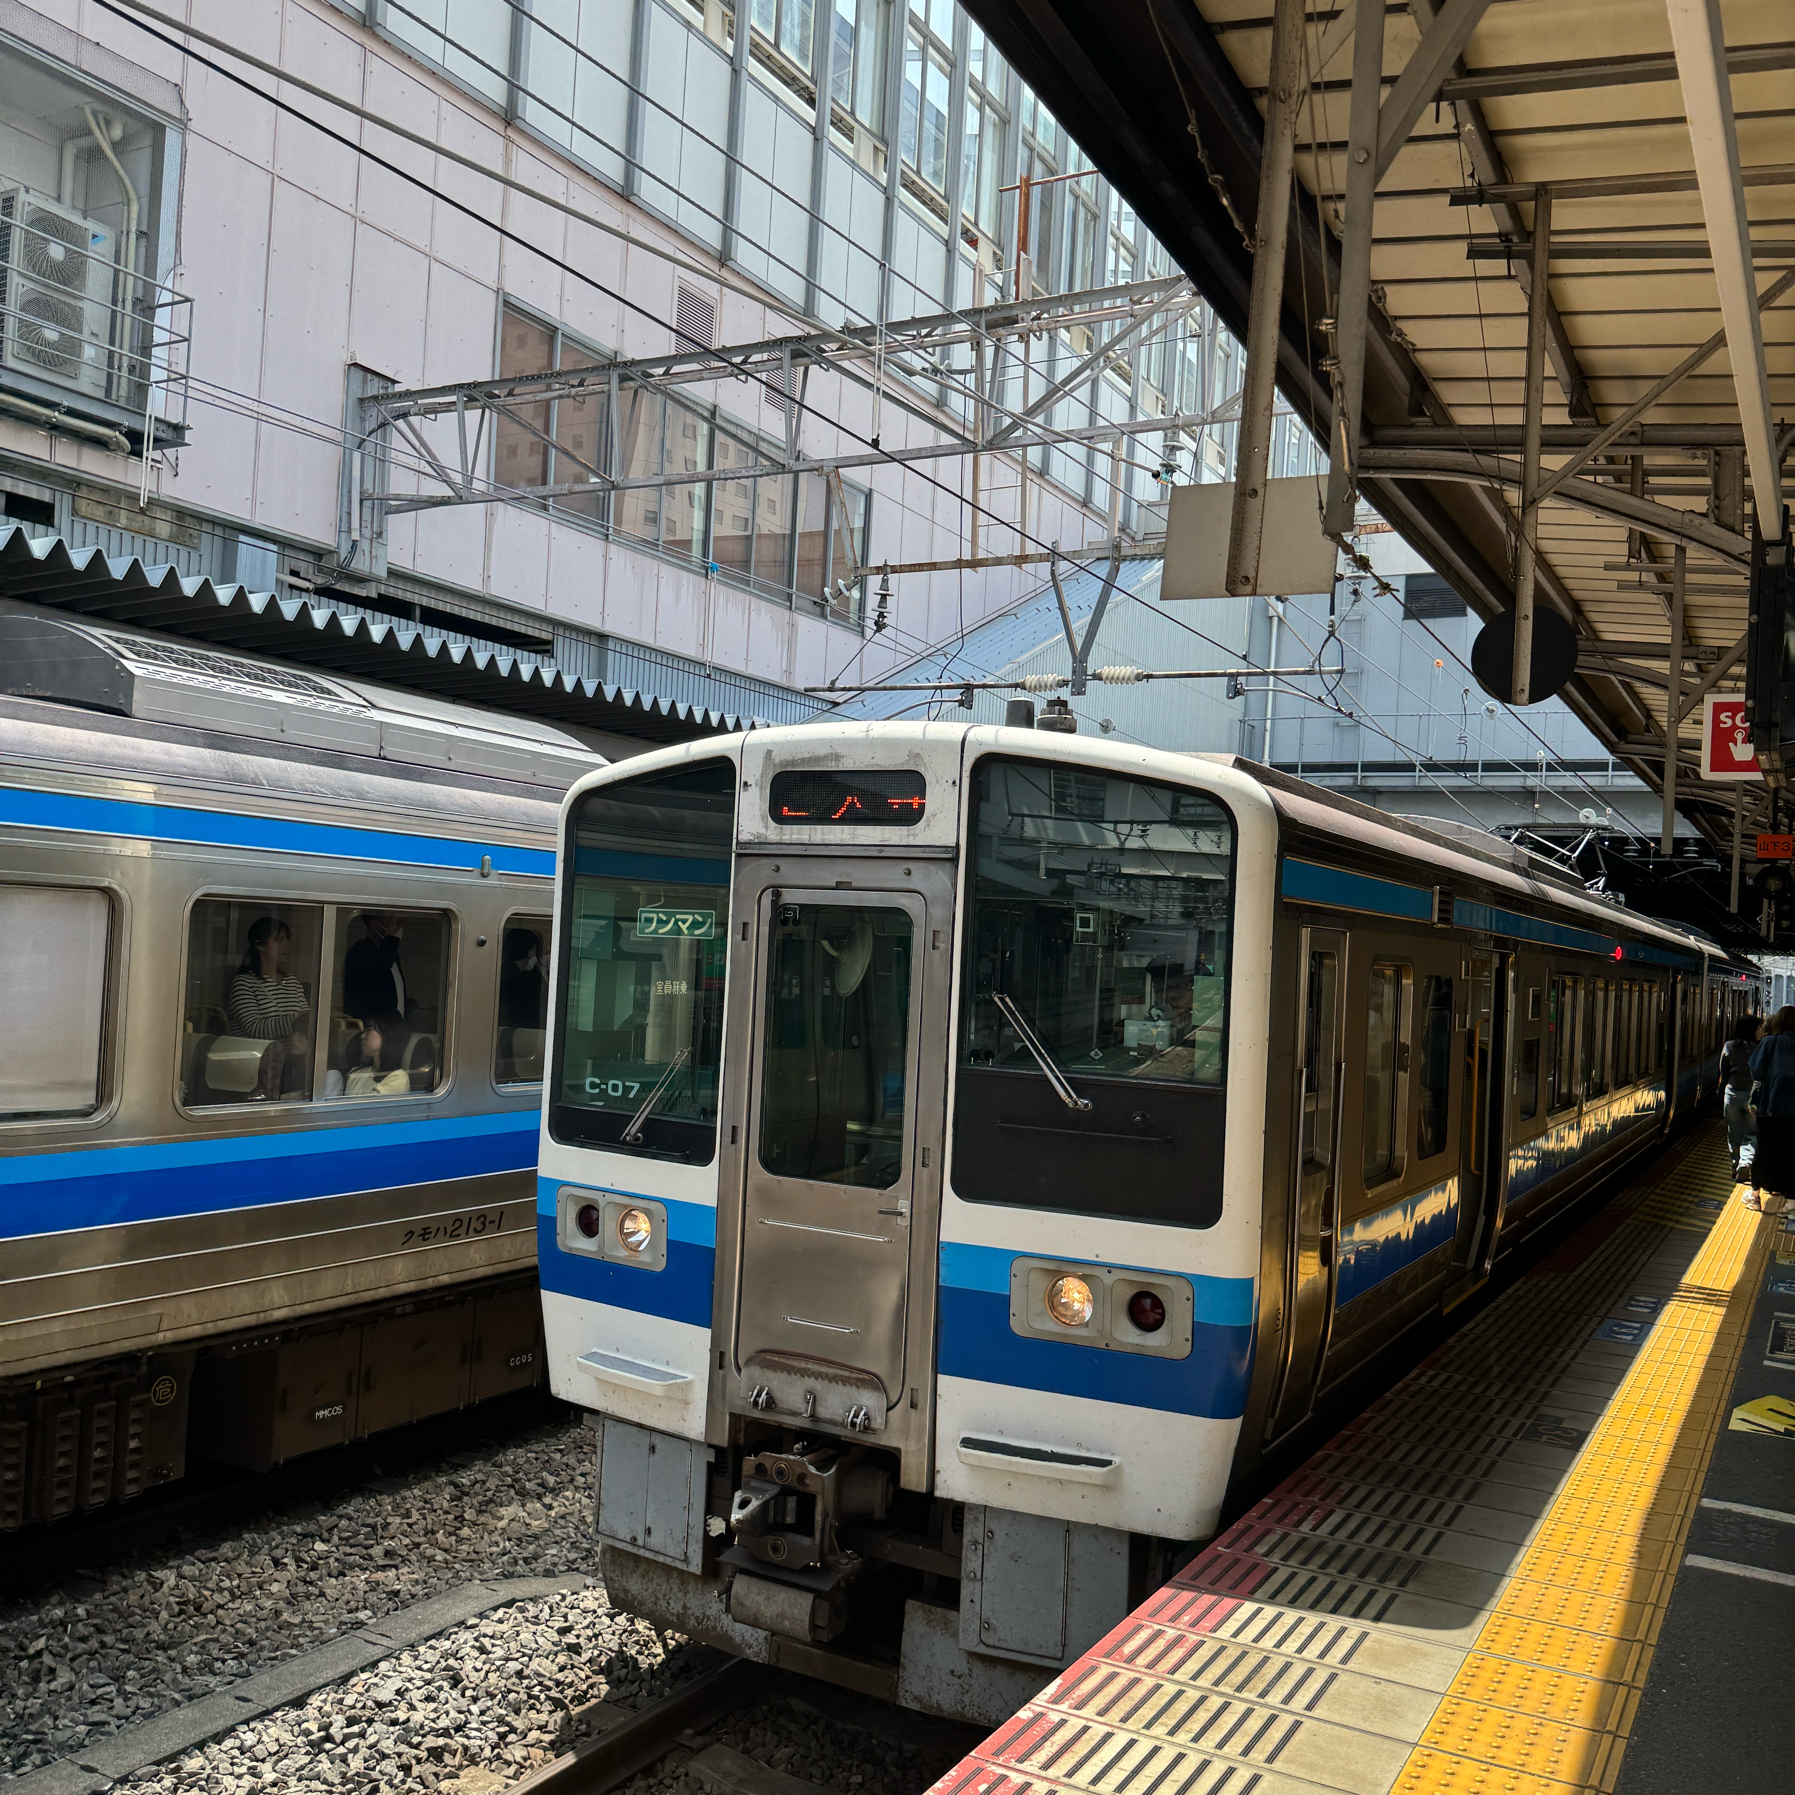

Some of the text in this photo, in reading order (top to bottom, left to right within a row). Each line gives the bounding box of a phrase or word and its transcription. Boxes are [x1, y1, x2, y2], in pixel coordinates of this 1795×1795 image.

[1759, 841, 1790, 851] 山下3
[640, 912, 712, 935] ワンマン
[585, 1076, 640, 1098] C-07
[401, 1210, 505, 1246] クモハ213-1
[153, 1378, 174, 1403] 危
